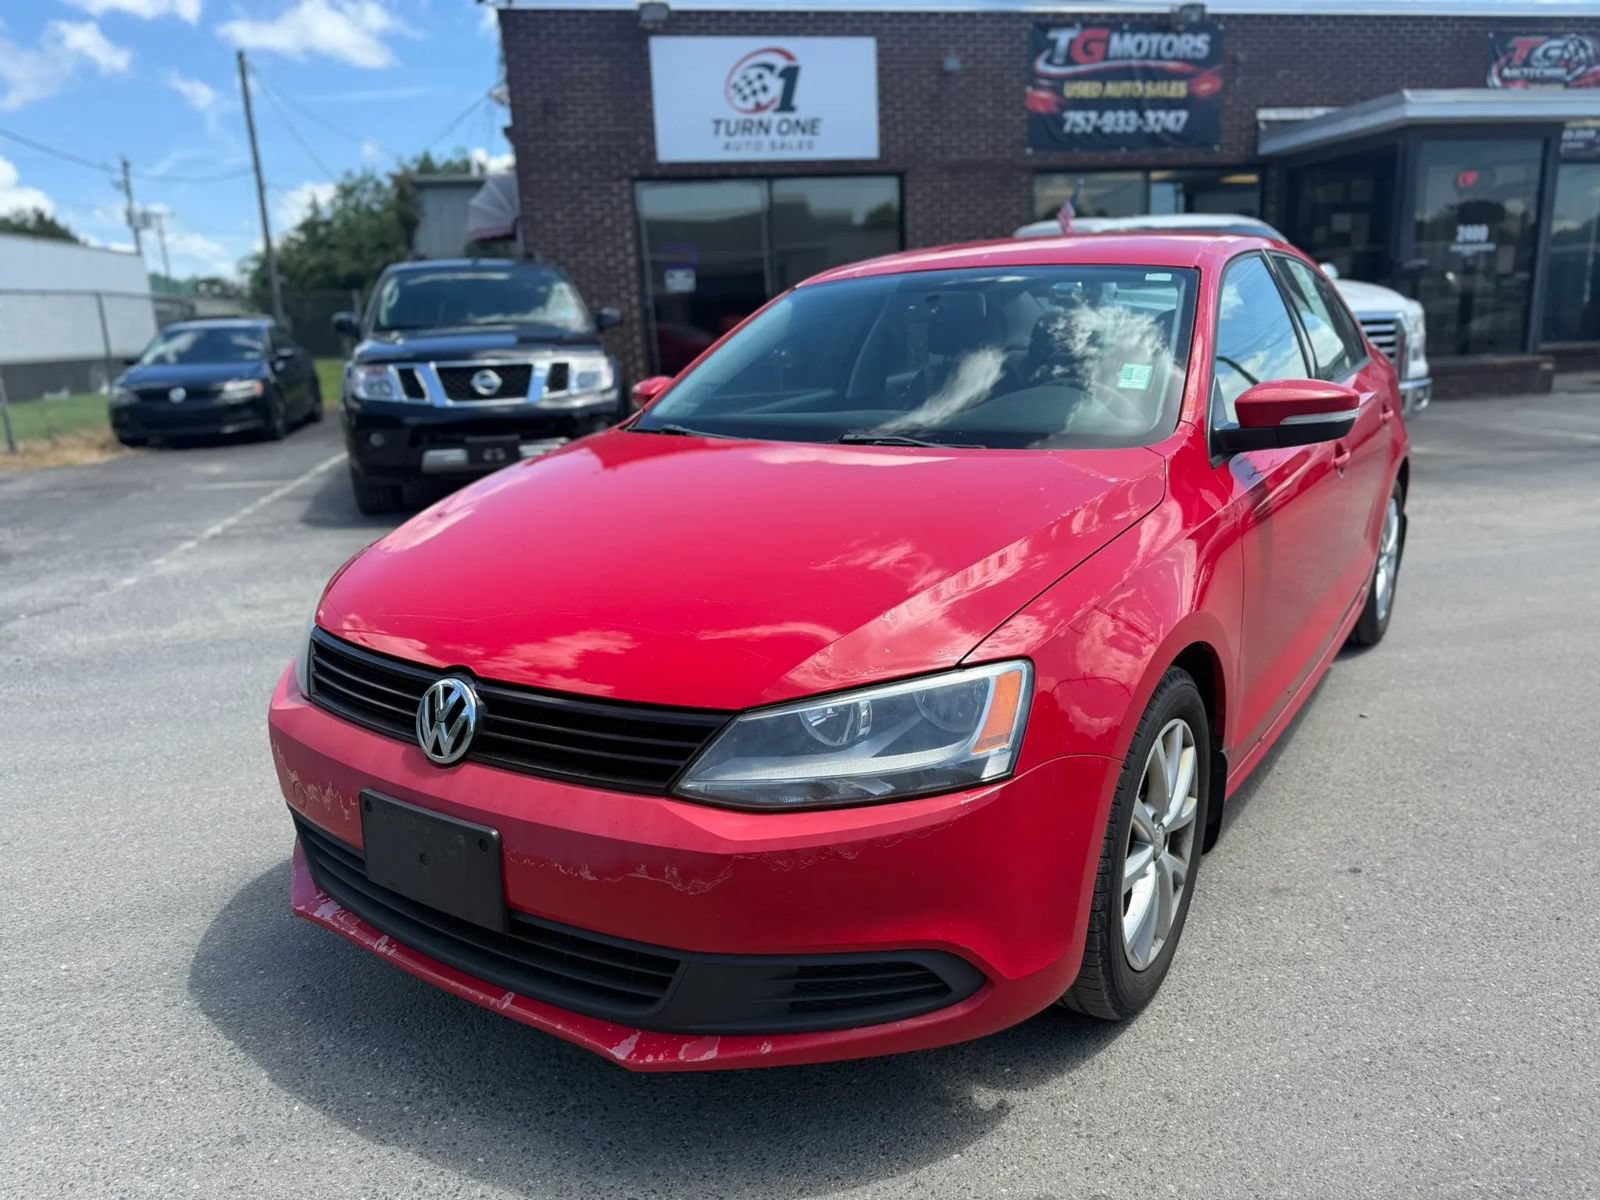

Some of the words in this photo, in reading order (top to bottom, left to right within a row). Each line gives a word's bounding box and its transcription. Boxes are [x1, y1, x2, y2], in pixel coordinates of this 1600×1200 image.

[1047, 27, 1110, 65] TG
[1109, 32, 1211, 60] MOTORS
[1063, 80, 1103, 99] USED
[1103, 80, 1144, 98] AUTO
[1144, 80, 1188, 98] SALES
[712, 118, 772, 136] TURN
[777, 118, 822, 136] ONE
[723, 141, 763, 151] AUTO
[769, 140, 814, 150] SALES
